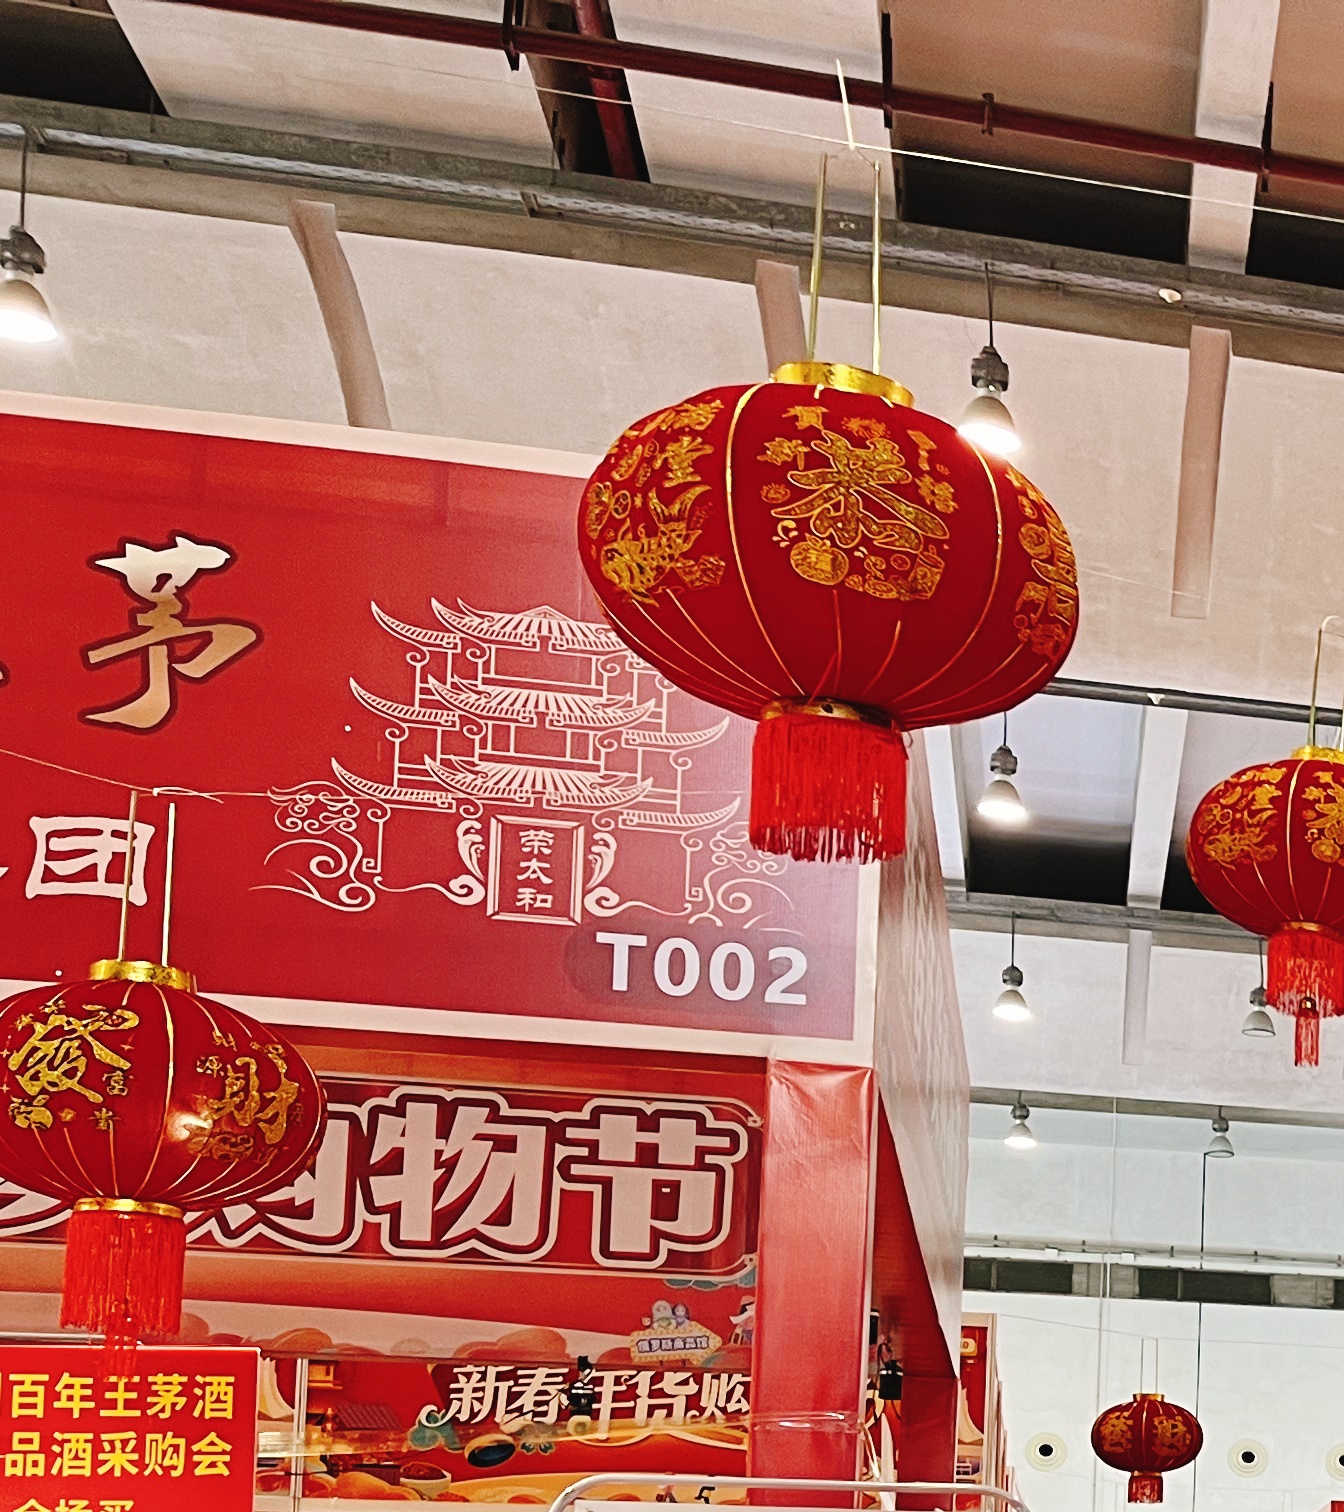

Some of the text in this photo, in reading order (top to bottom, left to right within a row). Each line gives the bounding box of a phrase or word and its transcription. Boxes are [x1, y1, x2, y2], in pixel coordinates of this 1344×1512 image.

[80, 532, 262, 731] 茅
[27, 815, 155, 906] 团
[518, 829, 553, 910] 荣太和
[597, 932, 808, 1005] T002
[0, 1372, 235, 1420] 百年王茅酒
[4, 1431, 233, 1478] 品酒采购会
